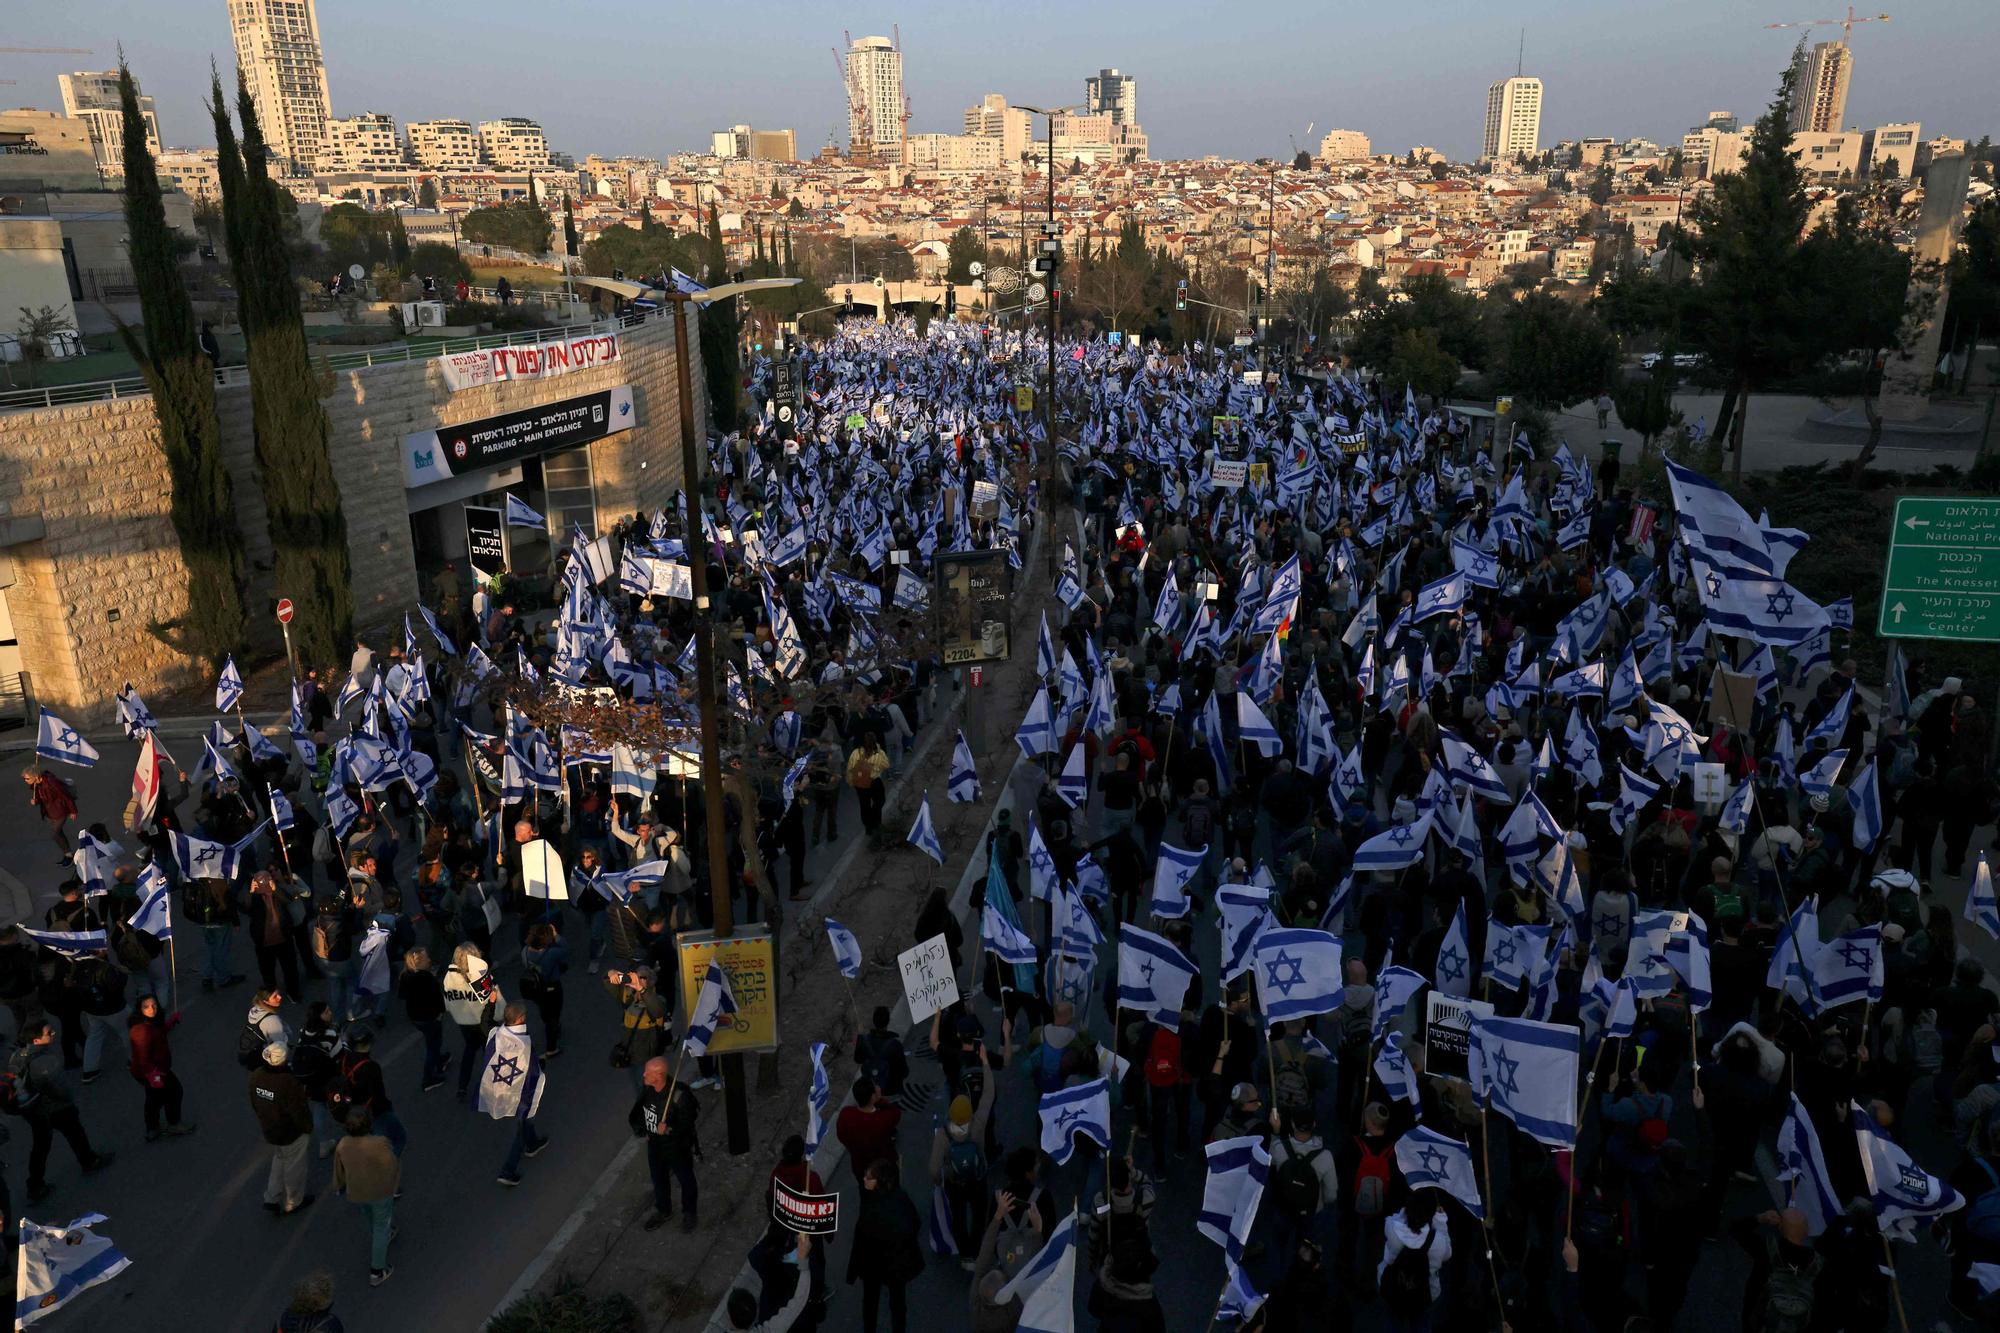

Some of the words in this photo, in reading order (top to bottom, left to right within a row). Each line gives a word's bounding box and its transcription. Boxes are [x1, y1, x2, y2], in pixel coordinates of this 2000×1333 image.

[547, 345, 570, 369] את
[569, 406, 588, 420] חניון
[541, 412, 568, 428] הלאום
[506, 420, 532, 437] כניסה
[471, 427, 504, 445] ראשית
[482, 437, 517, 455] PARKING
[524, 430, 543, 443] MAIN
[545, 421, 582, 438] ENTRANCE
[1945, 505, 1989, 516] הלאום
[479, 536, 501, 547] חניון
[1925, 531, 1979, 542] National
[472, 545, 502, 557] הלאום
[1937, 551, 1982, 563] הכנסת
[1915, 576, 1939, 585] The
[1945, 577, 1998, 588] Knesset
[1921, 596, 1953, 606] העיר
[1957, 597, 1991, 608] מרכז
[1928, 622, 1976, 632] Center
[920, 964, 934, 982] על
[1431, 1039, 1451, 1051] אחר
[818, 1201, 835, 1216] לא
